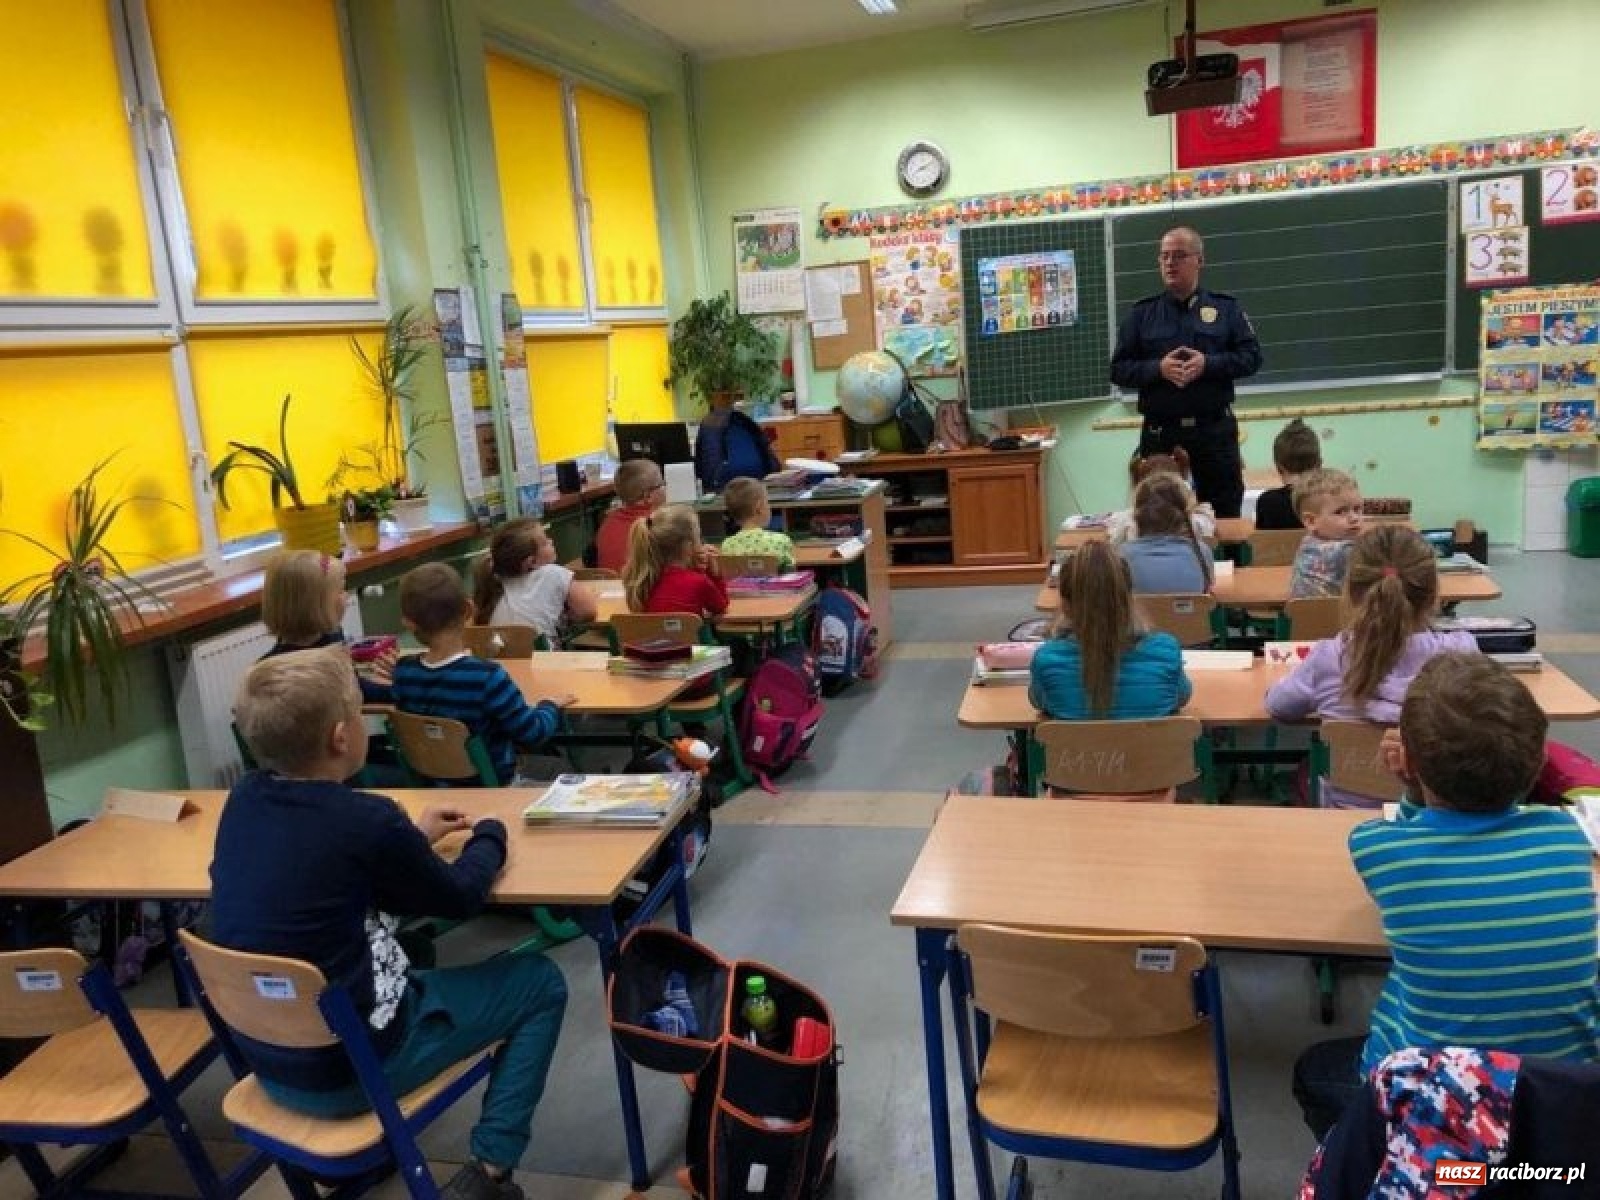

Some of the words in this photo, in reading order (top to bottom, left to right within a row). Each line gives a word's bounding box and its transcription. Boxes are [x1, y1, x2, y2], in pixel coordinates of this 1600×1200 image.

[1467, 184, 1481, 219] 1
[1546, 169, 1569, 206] 2
[1470, 233, 1493, 271] 3
